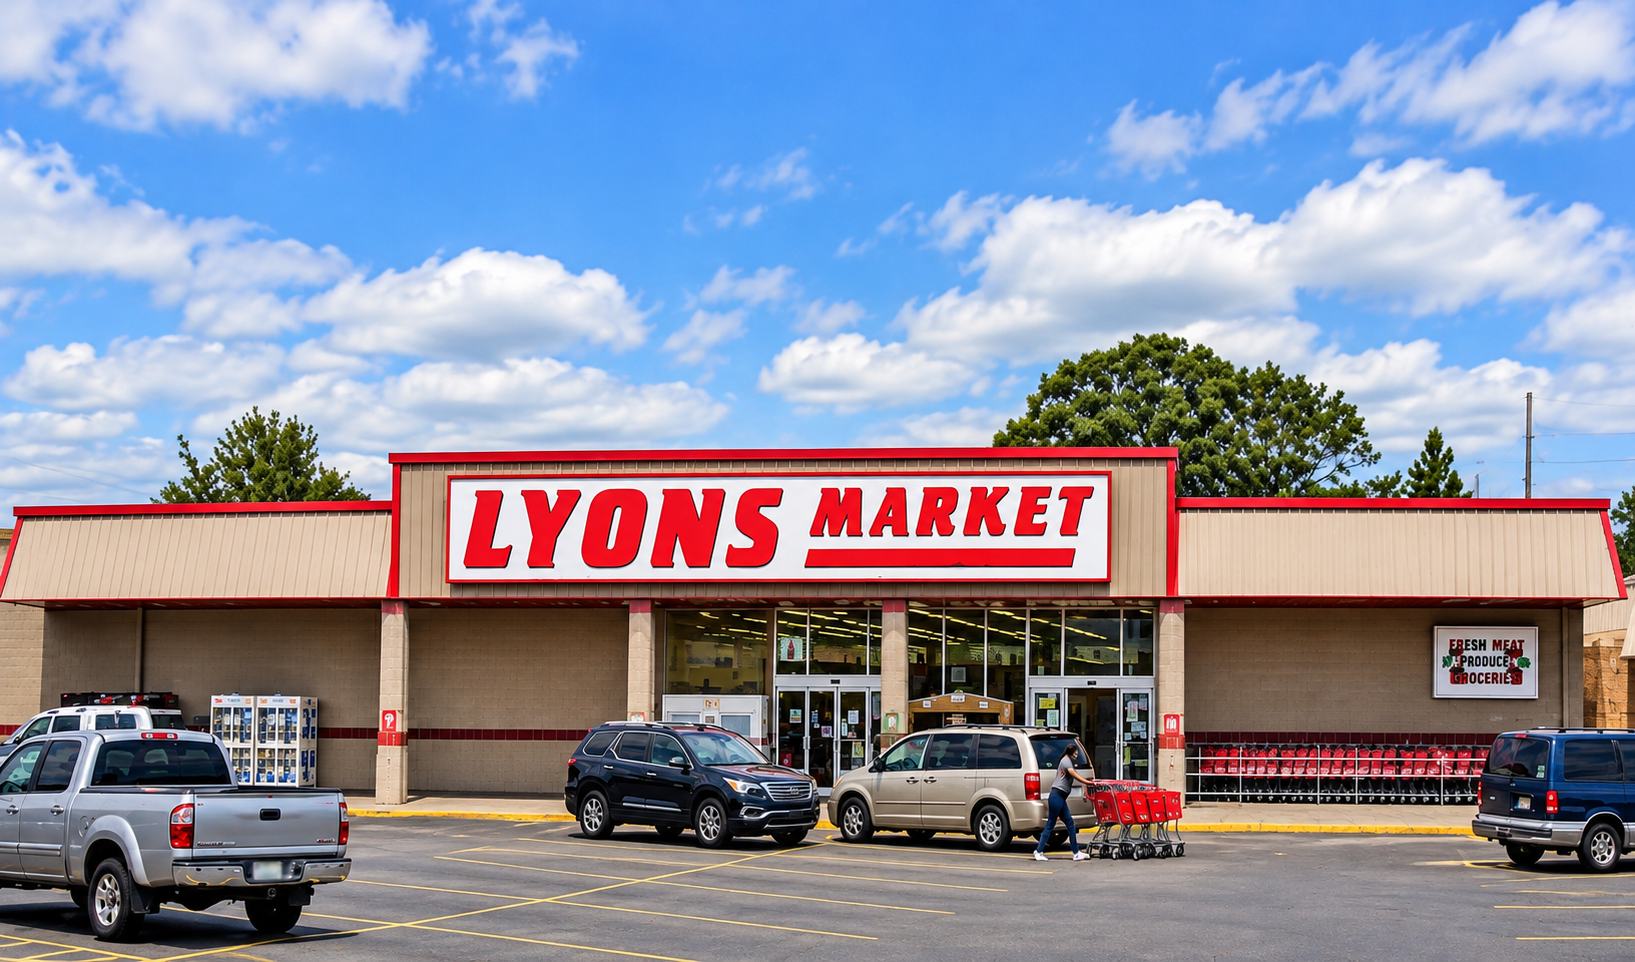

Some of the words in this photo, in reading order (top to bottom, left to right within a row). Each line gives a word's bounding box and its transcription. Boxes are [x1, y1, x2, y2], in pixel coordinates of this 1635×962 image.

[463, 488, 784, 568] LYONS
[809, 486, 1094, 537] MARKET
[1449, 639, 1486, 651] FRESH
[1492, 639, 1524, 651] MEAT
[1461, 656, 1508, 667] PRODUCE
